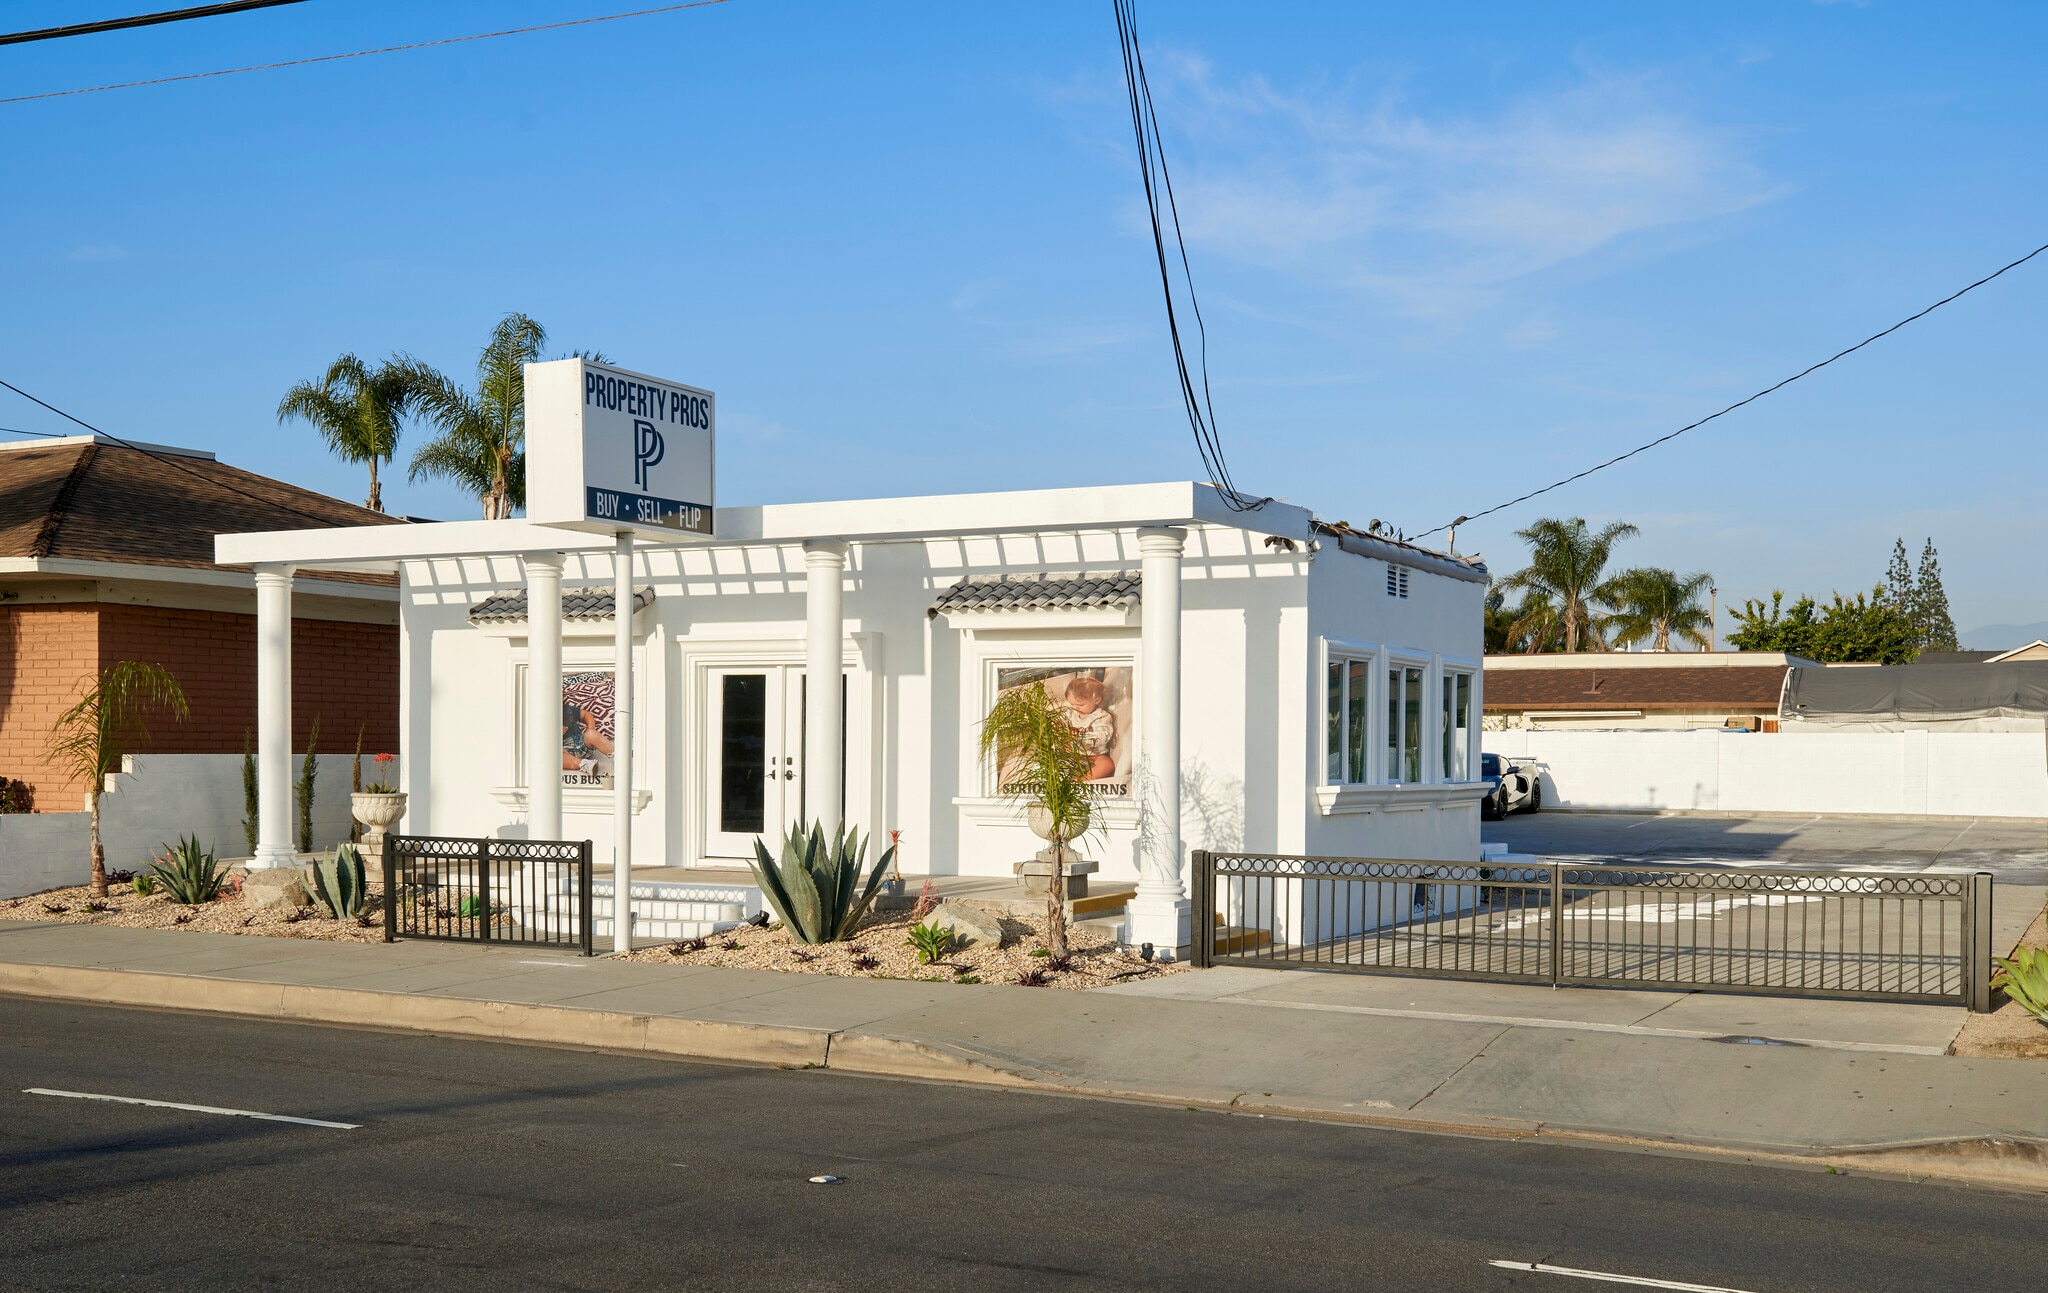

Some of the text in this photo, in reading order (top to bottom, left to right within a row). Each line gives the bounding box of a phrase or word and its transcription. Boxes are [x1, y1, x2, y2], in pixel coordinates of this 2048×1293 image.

[585, 371, 709, 430] PROPERTY PROS
[596, 492, 701, 529] BUY SELL FLIP
[562, 775, 578, 785] US
[1002, 783, 1128, 795] SERIO ETURNS
